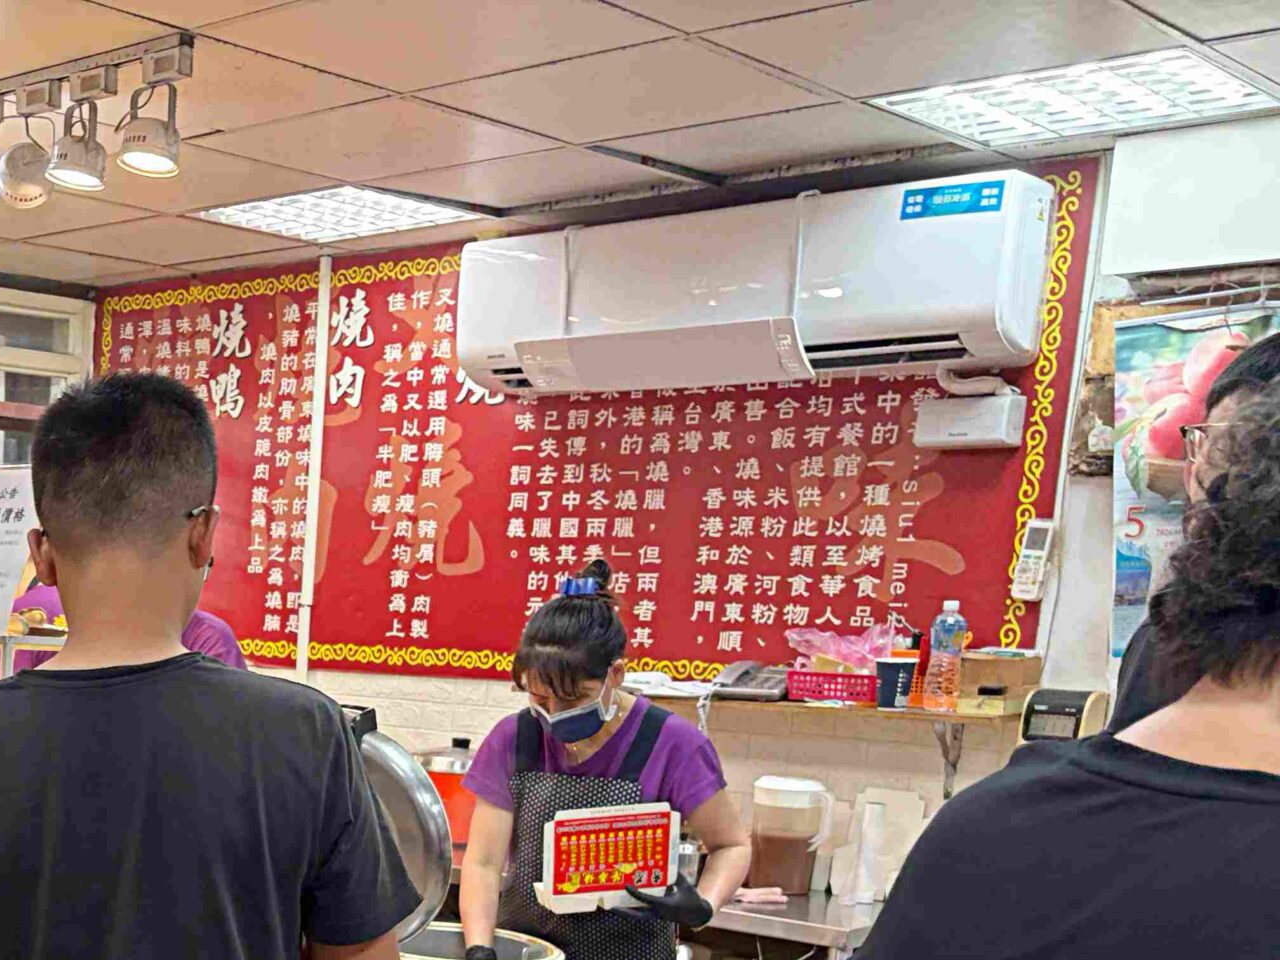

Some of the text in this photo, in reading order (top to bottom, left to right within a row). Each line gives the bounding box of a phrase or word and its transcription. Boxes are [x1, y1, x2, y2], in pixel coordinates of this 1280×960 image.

[210, 302, 251, 418] 燒鴨
[329, 288, 375, 408] 燒肉
[507, 396, 537, 558] 味一詞同義。
[850, 373, 905, 626] 中的一種燒烤食品
[1124, 505, 1146, 539] 5
